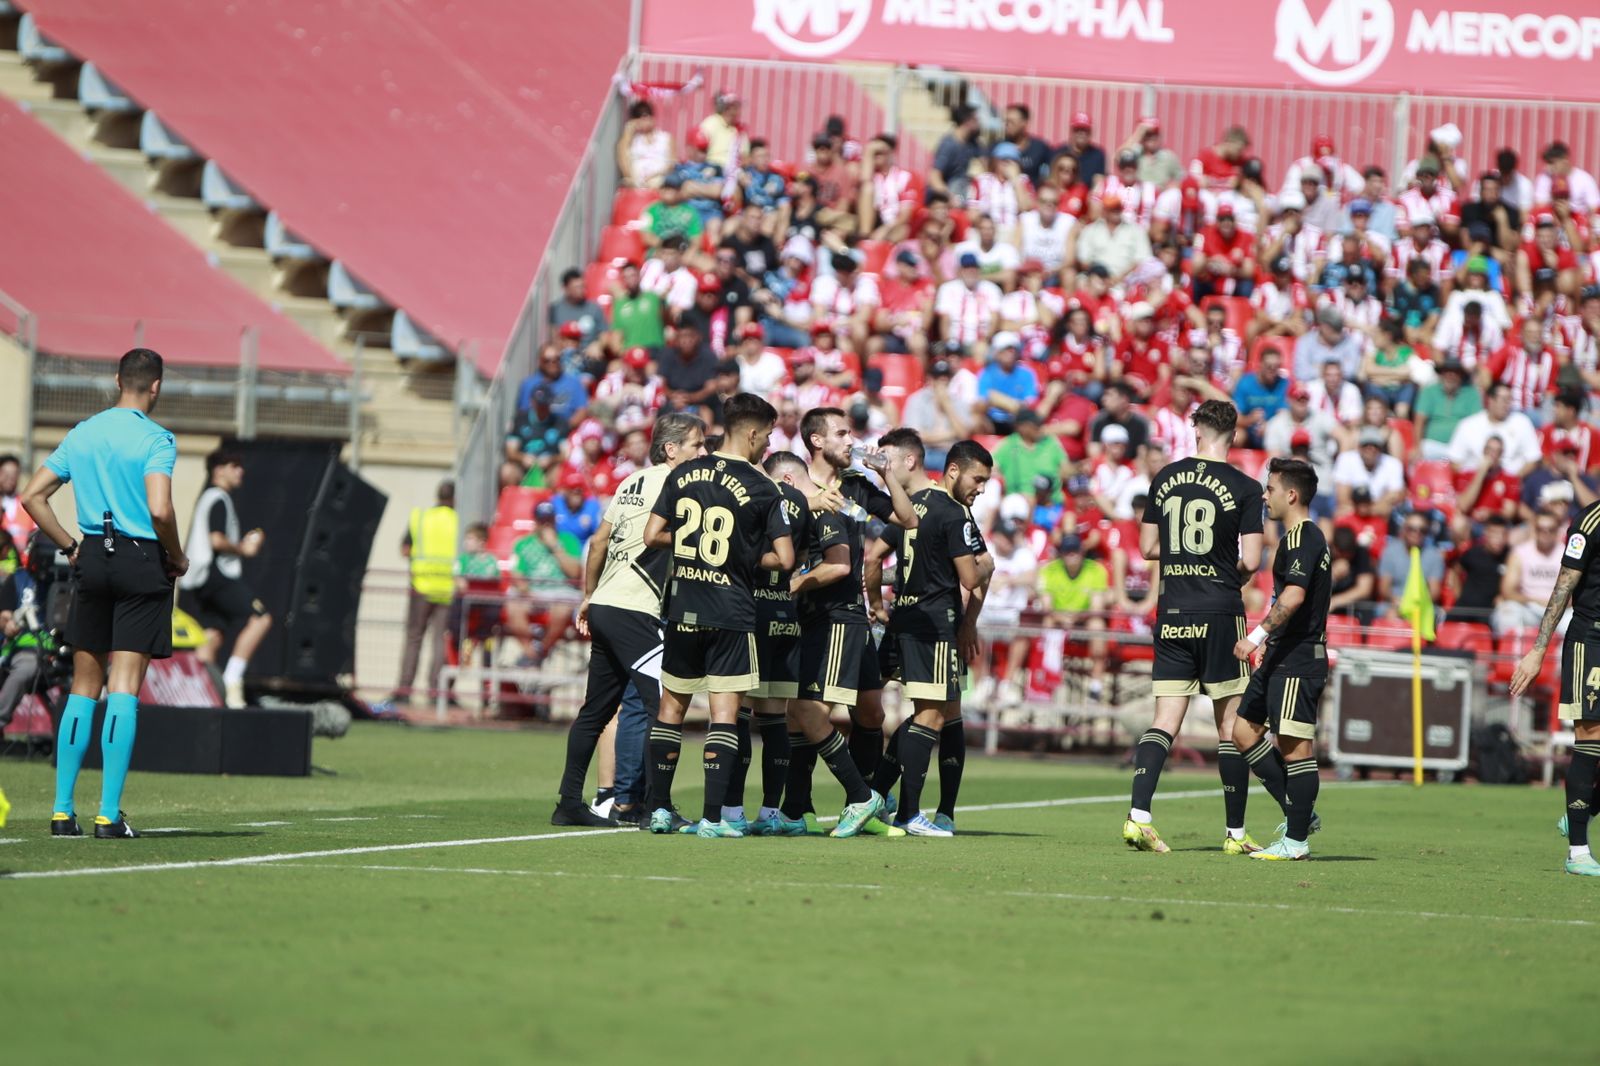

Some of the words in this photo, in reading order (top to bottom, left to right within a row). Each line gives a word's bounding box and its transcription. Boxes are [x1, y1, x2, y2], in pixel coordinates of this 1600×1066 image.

[882, 0, 1174, 43] MERCOPHAL
[677, 468, 715, 489] GABRI
[720, 473, 751, 506] VEIGA
[1156, 471, 1195, 507] STRAND
[1196, 472, 1236, 512] LARSEN
[674, 497, 734, 567] 28
[1162, 495, 1216, 555] 18
[903, 528, 918, 584] 5
[1164, 564, 1217, 576] ABANCA
[676, 565, 731, 586] ABANCA
[754, 588, 792, 601] ABANC
[1160, 623, 1208, 639] Recalvi
[951, 649, 958, 671] 5
[1586, 666, 1600, 690] 4
